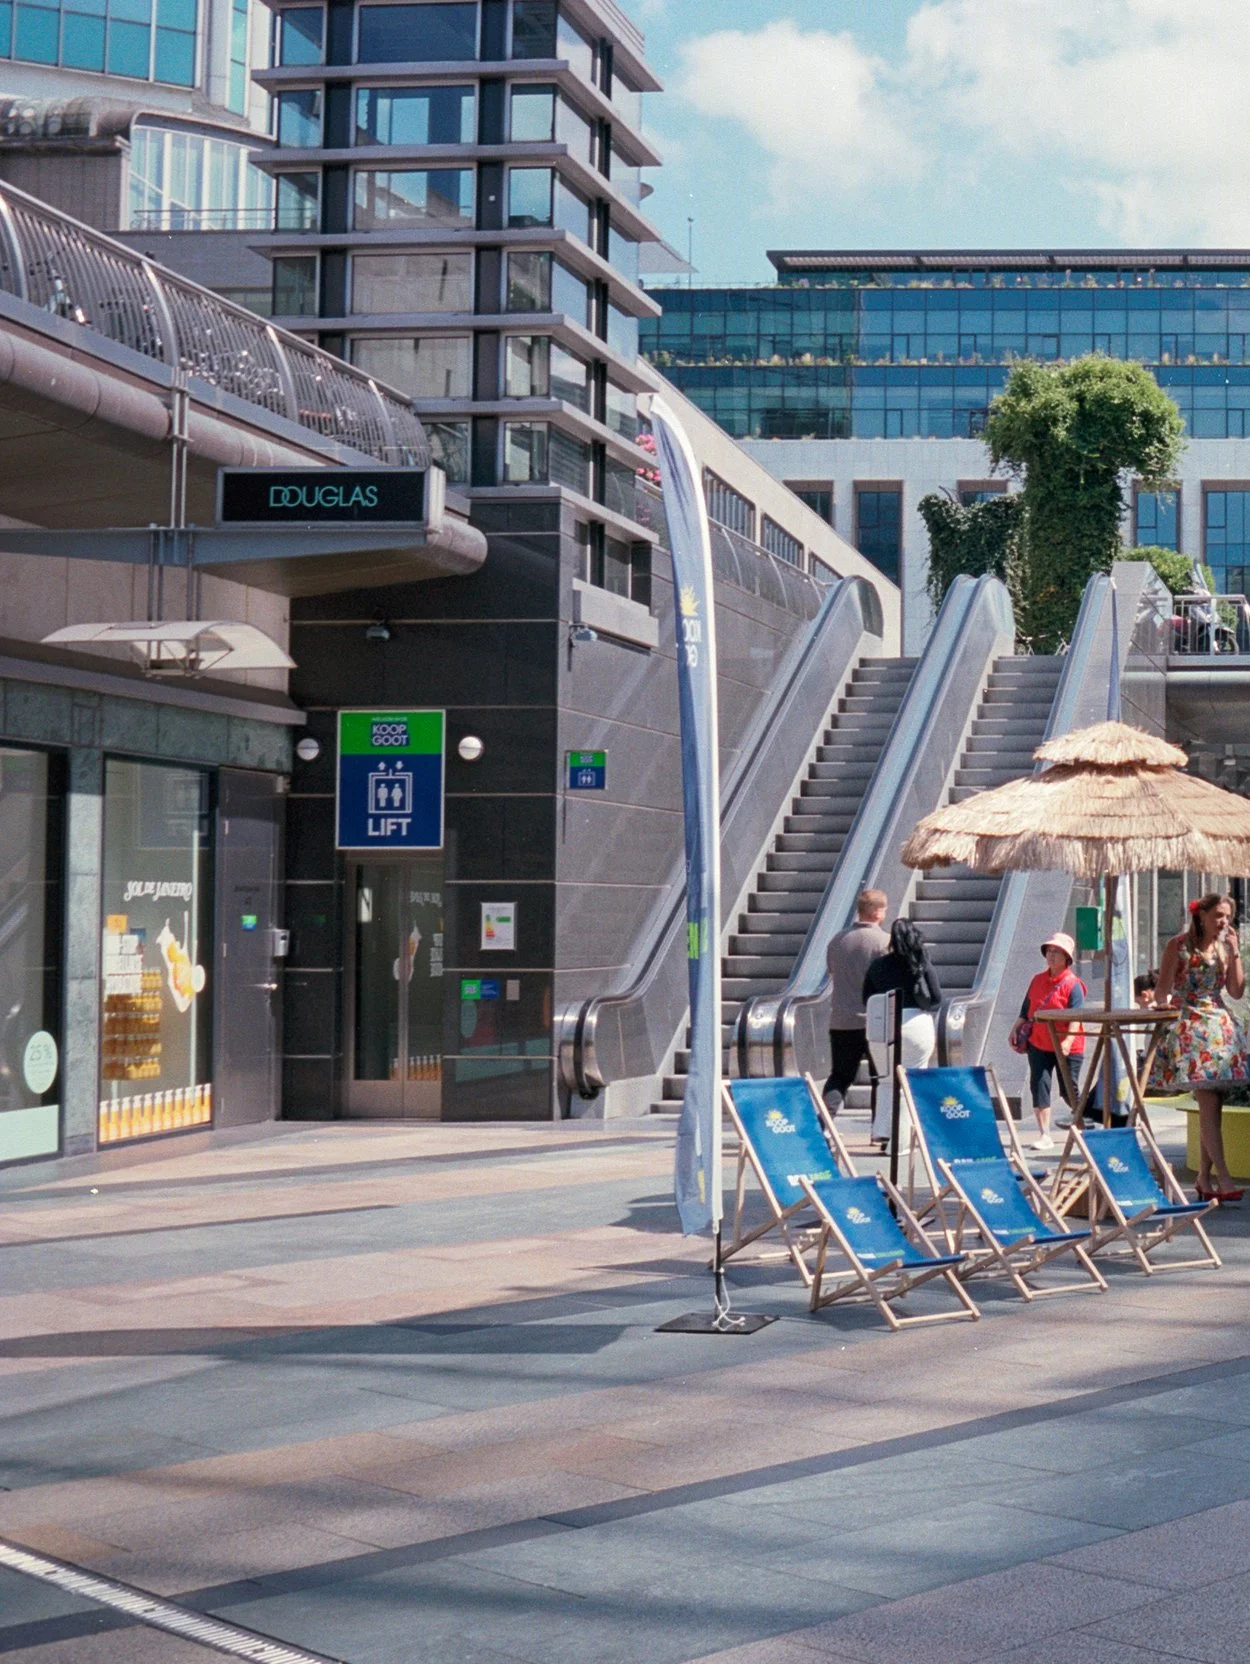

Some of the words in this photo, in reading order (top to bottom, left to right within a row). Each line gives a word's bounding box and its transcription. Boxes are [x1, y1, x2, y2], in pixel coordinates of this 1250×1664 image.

[269, 485, 379, 508] DOUGLAS
[372, 724, 407, 735] KOOP
[372, 735, 408, 746] GOOT
[367, 818, 411, 836] LIFT
[941, 1104, 964, 1113] KOOP
[945, 1110, 971, 1119] GOOT
[765, 1118, 788, 1128] KOOP
[772, 1124, 796, 1134] GOOT
